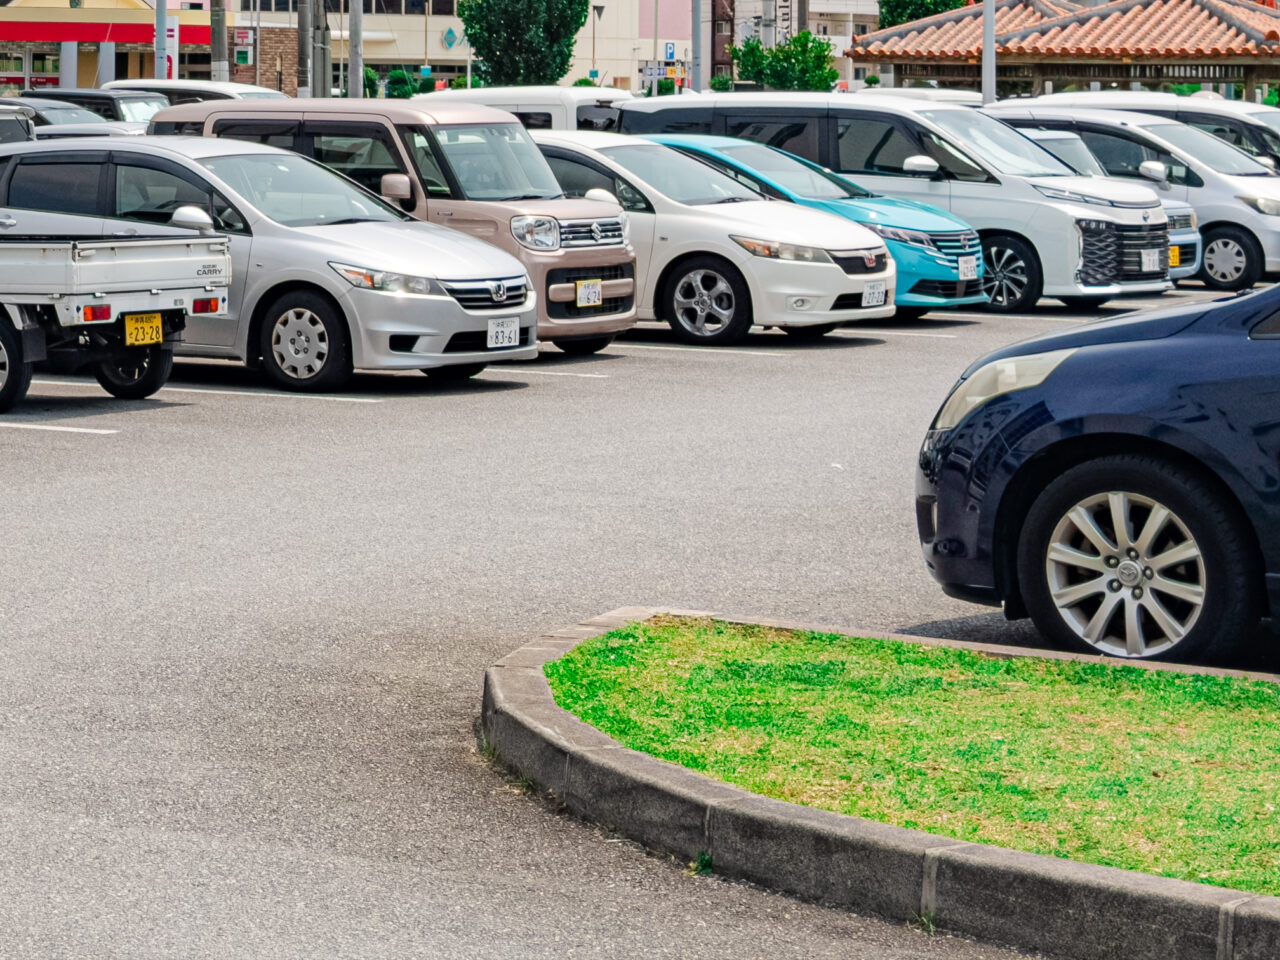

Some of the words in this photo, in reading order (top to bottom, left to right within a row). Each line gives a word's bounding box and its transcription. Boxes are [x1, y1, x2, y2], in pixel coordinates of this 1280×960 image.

[666, 43, 674, 59] P
[196, 268, 223, 276] CARRY
[134, 325, 161, 342] 23-28
[494, 329, 517, 345] 83-61
